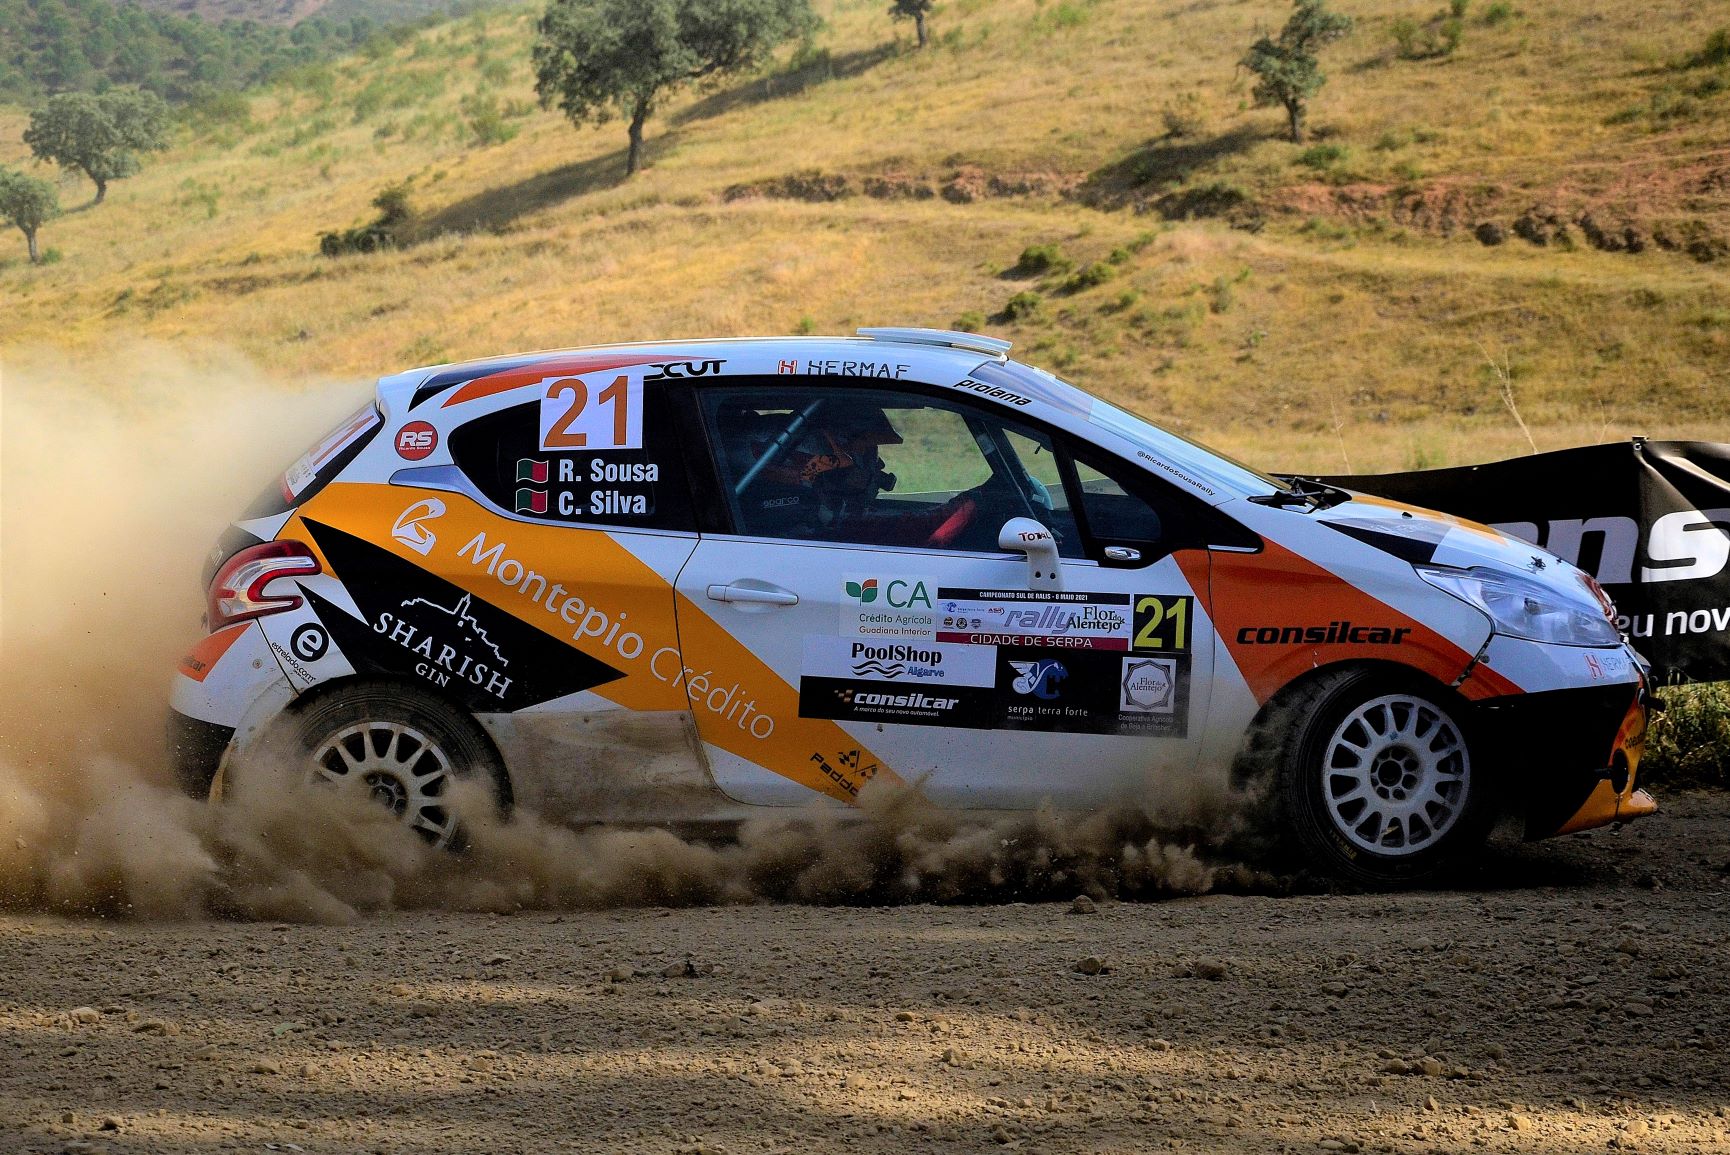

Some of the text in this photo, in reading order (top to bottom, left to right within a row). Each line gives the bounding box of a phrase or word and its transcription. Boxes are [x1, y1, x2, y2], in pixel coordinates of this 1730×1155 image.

[808, 360, 911, 379] HERMAF
[953, 379, 1032, 405] prolama
[543, 375, 628, 447] 21
[400, 431, 433, 447] RS
[559, 459, 659, 482] R. Sousa
[1137, 450, 1216, 497] @RicardoSousaRally
[559, 490, 647, 515] C. Silva
[886, 580, 932, 608] CA
[980, 591, 1015, 599] CAMPEONATO
[859, 613, 893, 623] Crédito
[1004, 606, 1076, 634] rally
[1083, 605, 1114, 620] Flor
[1133, 597, 1187, 649] 21
[456, 531, 774, 739] Montepio Crédito
[859, 626, 931, 636] Guadiana Interior
[1065, 616, 1121, 633] Alentejo
[1237, 621, 1411, 644] consilcar
[970, 634, 1093, 648] CIDADE DE SERPA
[271, 642, 315, 682] estrelado.com
[373, 613, 513, 699] SHARISH
[851, 642, 942, 666] PoolShop
[415, 662, 450, 687] GIN
[907, 666, 945, 677] Algarve
[1141, 677, 1156, 685] Flor
[1130, 682, 1163, 692] Alentejo
[854, 693, 959, 710] consilcar
[1008, 706, 1088, 717] serpa terra forte
